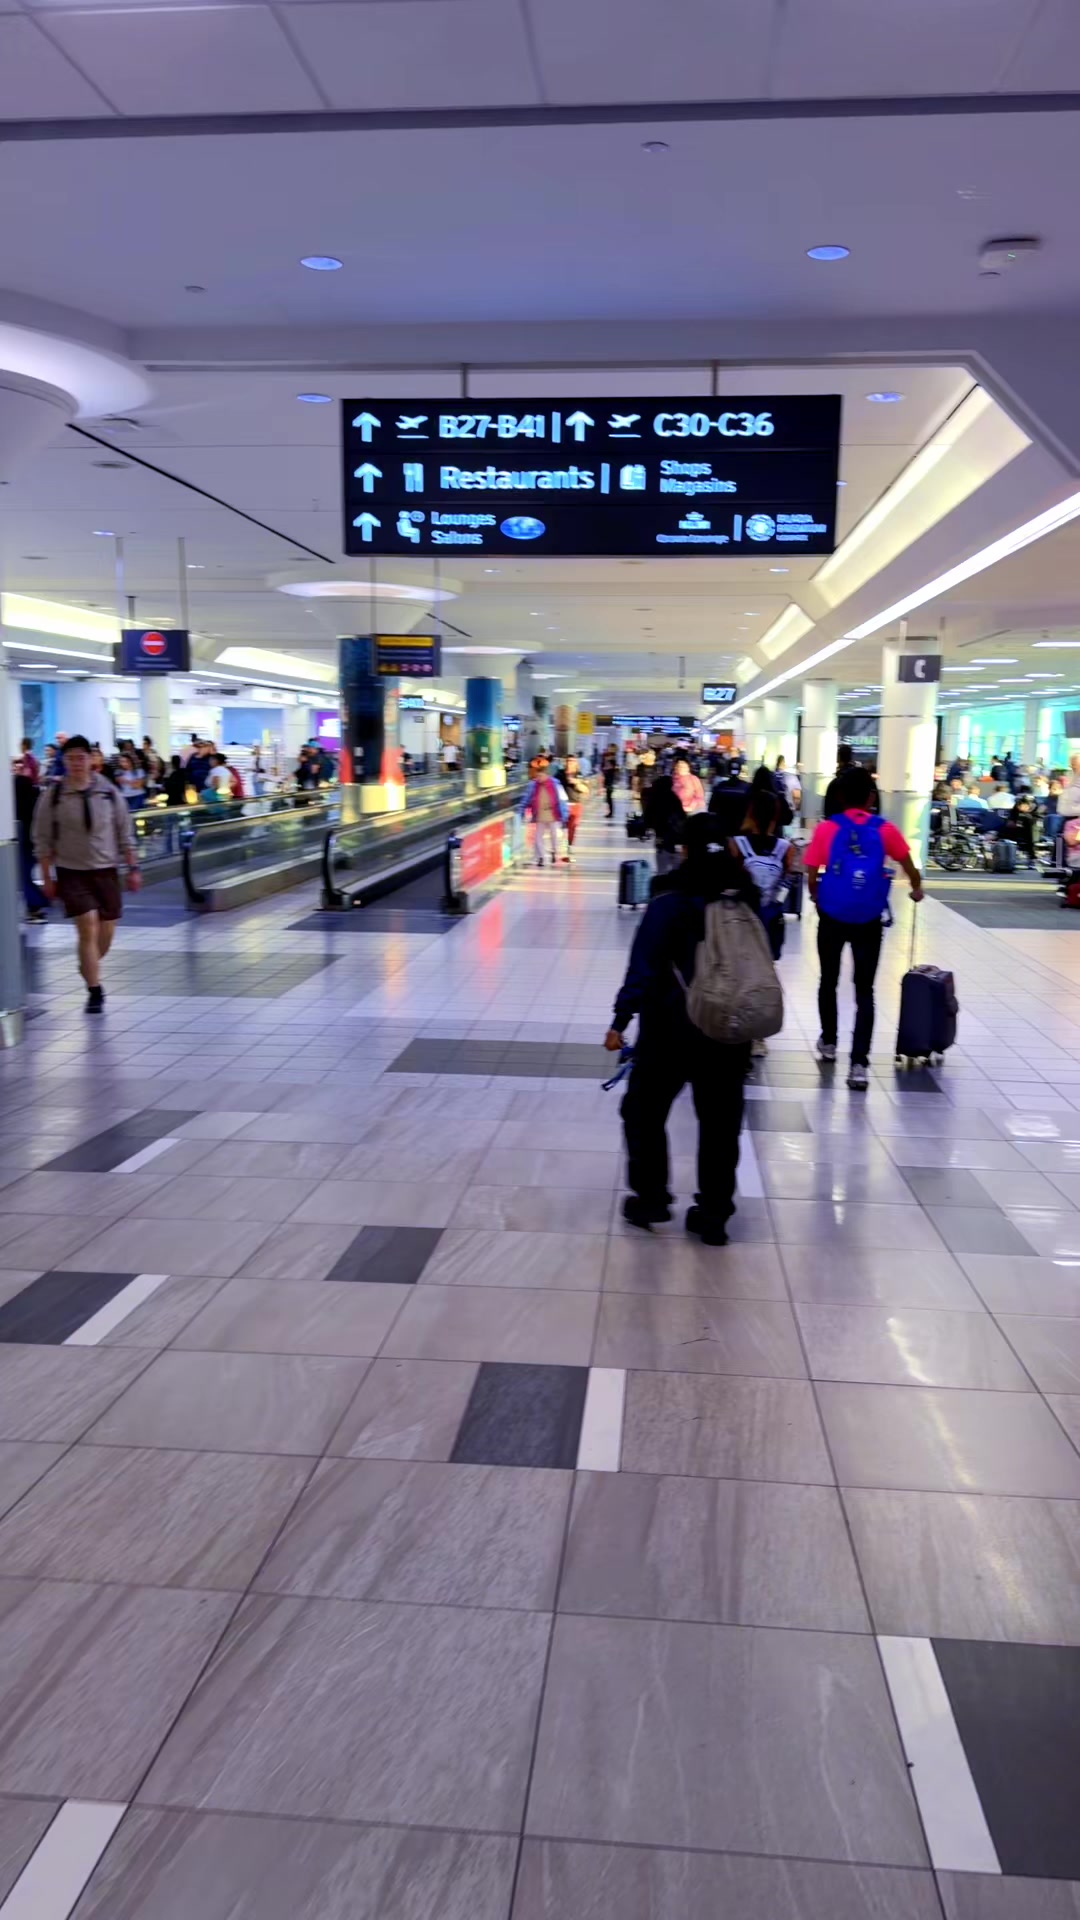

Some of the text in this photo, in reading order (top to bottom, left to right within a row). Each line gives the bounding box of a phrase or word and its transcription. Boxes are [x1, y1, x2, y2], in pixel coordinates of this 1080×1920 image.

[438, 414, 546, 438] B27-B41
[653, 412, 775, 437] C30-C36
[440, 465, 596, 490] Restaurants
[659, 460, 712, 477] Shops
[659, 477, 738, 496] Magasins
[430, 511, 497, 528] Lounges
[430, 530, 483, 545] Salons
[914, 659, 926, 678] C
